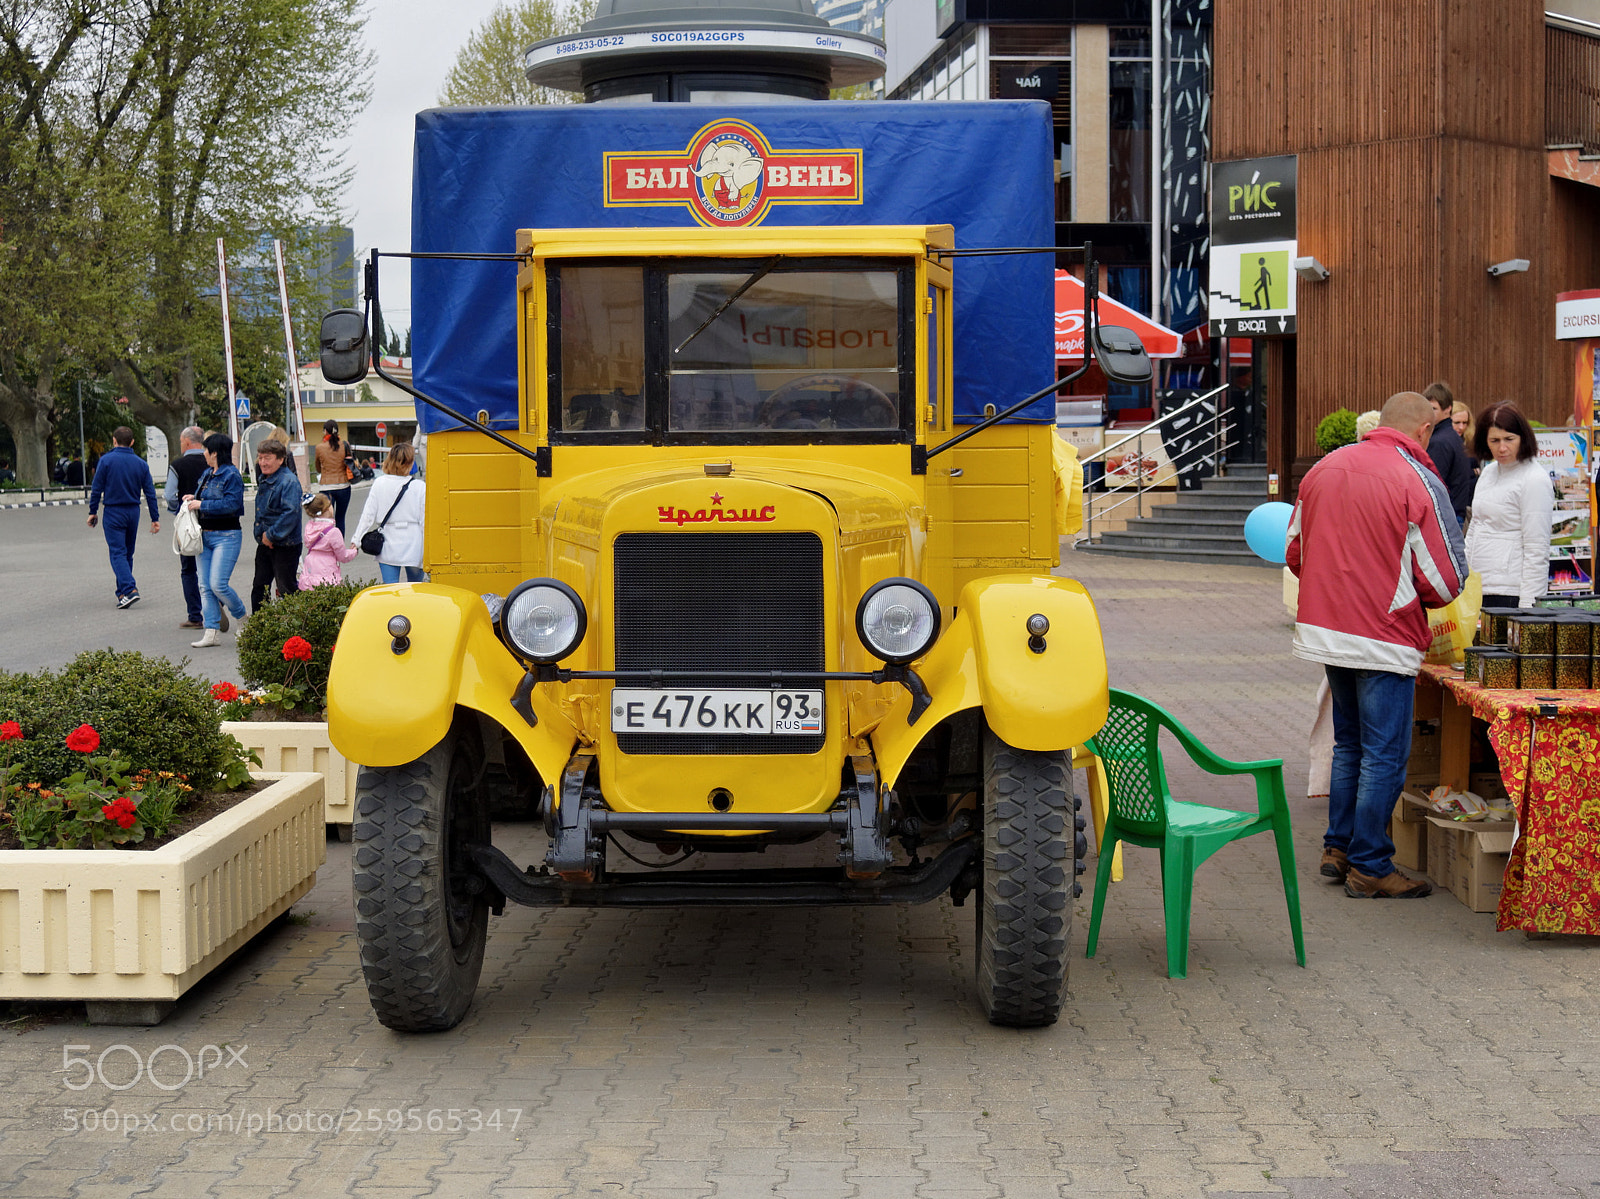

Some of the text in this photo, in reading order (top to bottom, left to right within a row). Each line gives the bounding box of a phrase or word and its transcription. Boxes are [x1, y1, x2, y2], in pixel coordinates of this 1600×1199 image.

[556, 32, 842, 54] 8-988-233-05-22 SOC019A2GGPS Gallery
[1015, 74, 1041, 88] ЧАЙ
[626, 165, 853, 190] БАЛ ВЕНЬ
[700, 196, 760, 220] ВСЕГДА ПОПУЛЯРЕН
[1228, 211, 1282, 221] СЕТЬ РЕСТОРАНОВ
[1237, 319, 1267, 333] ВХОД
[1536, 449, 1565, 458] РСИИ
[776, 693, 810, 720] 93
[775, 720, 800, 731] RUS
